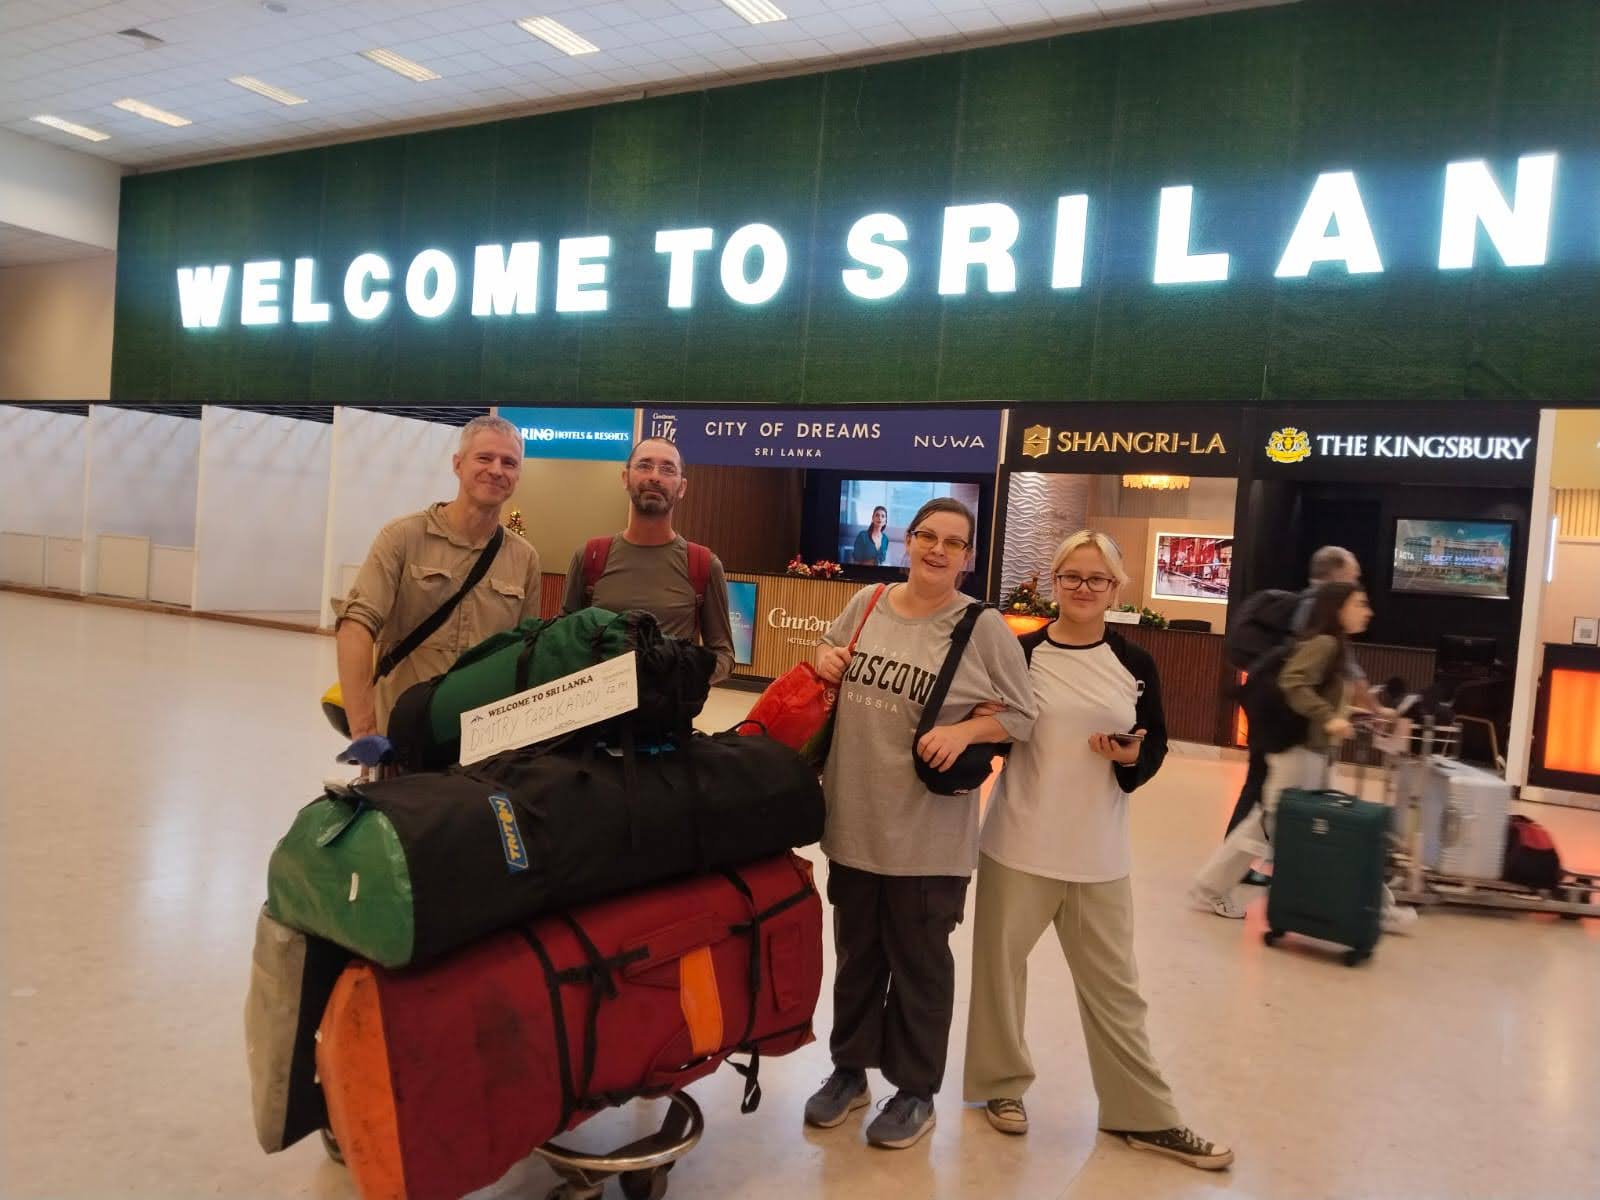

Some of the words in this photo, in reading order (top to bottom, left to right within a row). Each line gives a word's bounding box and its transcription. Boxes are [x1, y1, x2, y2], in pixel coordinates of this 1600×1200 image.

[176, 235, 611, 330] WELCOME
[654, 223, 789, 310] TO
[842, 193, 1089, 303] SRI
[520, 428, 554, 441] RINO
[705, 421, 747, 436] CITY
[759, 422, 784, 438] OF
[796, 423, 881, 439] DREAMS
[754, 447, 774, 456] SRI
[780, 448, 822, 458] LANKA
[1056, 431, 1227, 454] SHANGRI-LA
[1316, 435, 1367, 456] THE
[1374, 436, 1531, 460] KINGSBURY
[488, 697, 530, 717] WELCOME
[531, 692, 544, 703] TO
[545, 685, 560, 698] SRI
[561, 674, 594, 693] LANKA
[847, 691, 898, 713] RUSSIA
